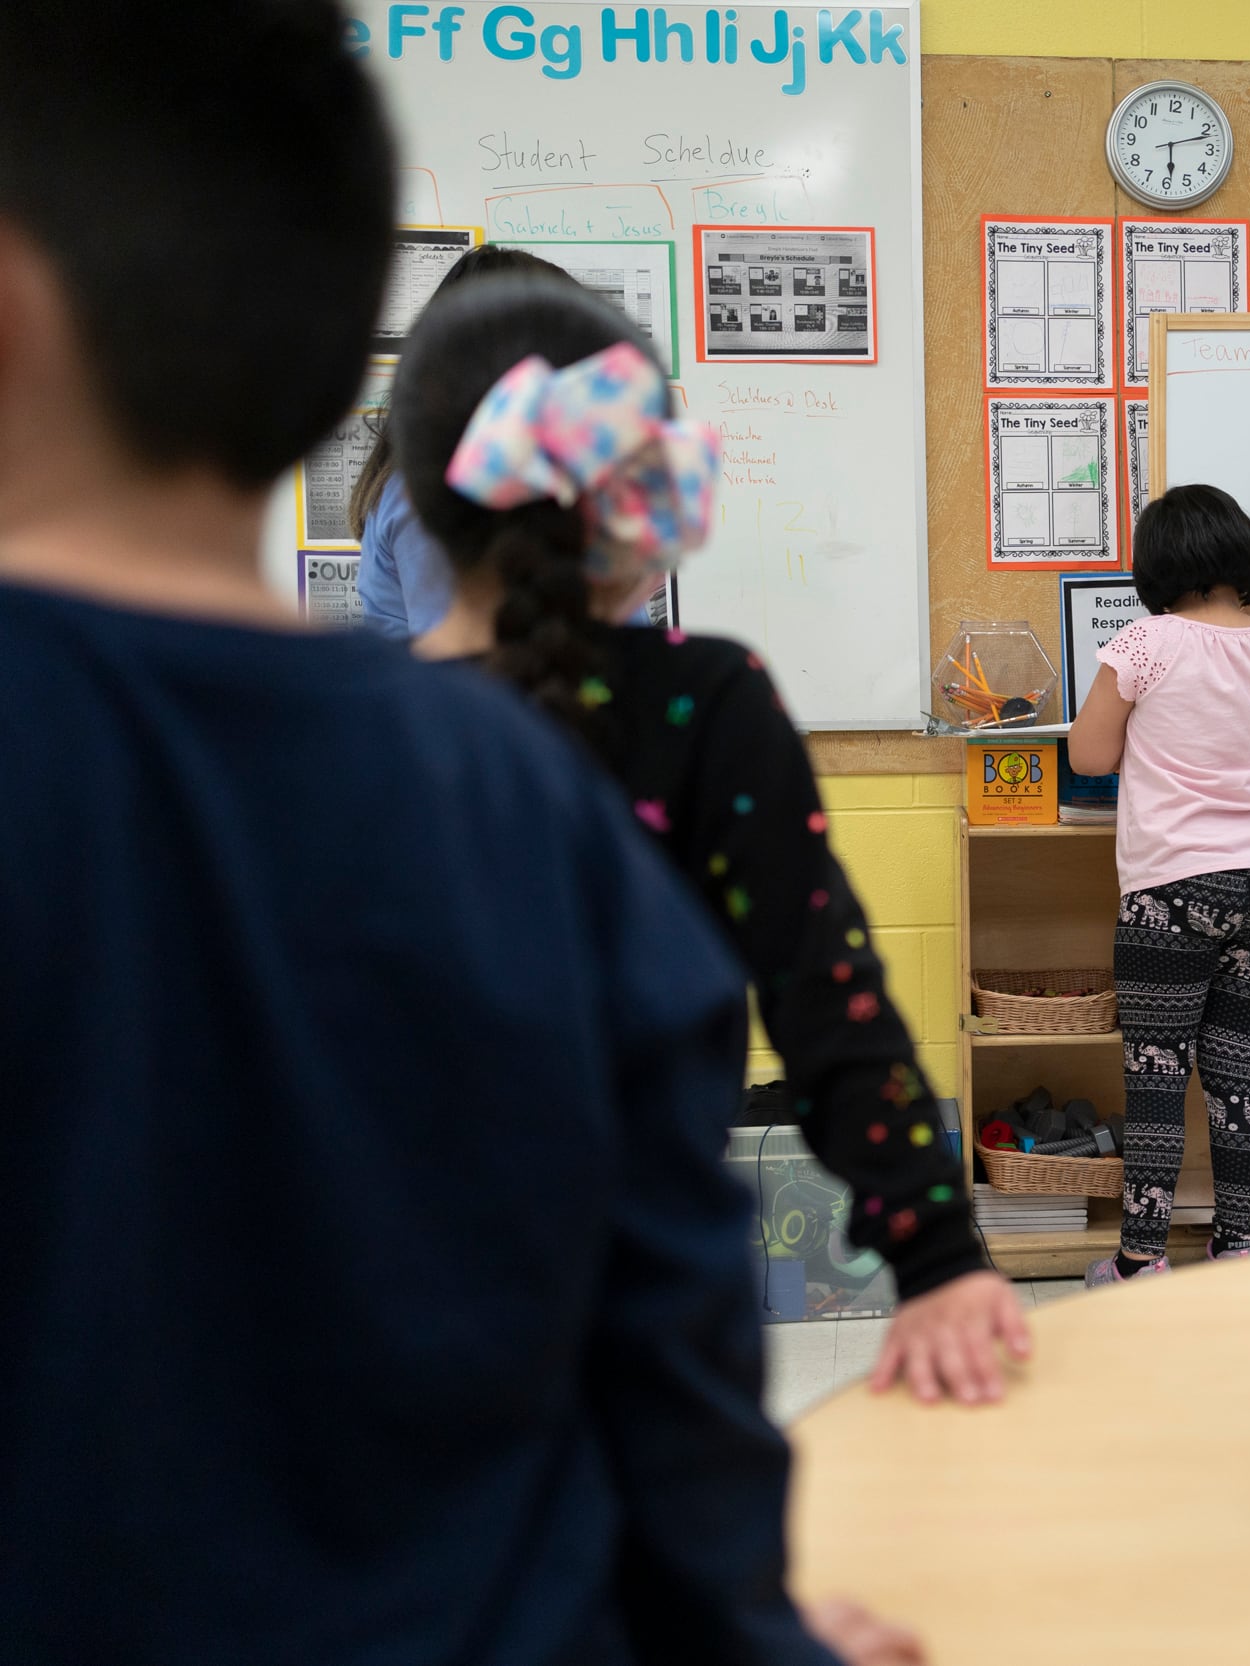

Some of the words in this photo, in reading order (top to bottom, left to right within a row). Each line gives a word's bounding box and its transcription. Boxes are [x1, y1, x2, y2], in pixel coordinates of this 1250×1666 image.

[388, 4, 465, 61] Ff
[482, 5, 582, 80] Gg
[601, 7, 694, 63] Hh
[750, 9, 806, 96] Jj
[817, 9, 907, 65] Kk
[1150, 102, 1158, 116] 11
[1169, 99, 1183, 113] 12
[1134, 115, 1148, 129] 10
[1201, 122, 1212, 136] 2
[1126, 132, 1136, 146] 9
[478, 131, 598, 171] Student
[643, 134, 775, 168] Scheldue
[1205, 143, 1215, 156] 3
[1130, 153, 1140, 167] 8
[1144, 169, 1154, 182] 7
[1197, 162, 1207, 175] 4
[1161, 176, 1171, 190] 6
[1182, 173, 1192, 187] 5
[605, 205, 664, 239] Jesus
[997, 242, 1017, 253] The
[1020, 243, 1043, 255] Tiny
[1046, 243, 1075, 254] Seed
[1134, 241, 1154, 252] The
[1157, 242, 1179, 254] Tiny
[1182, 243, 1211, 253] Seed
[804, 390, 839, 411] Desk
[1000, 417, 1020, 429] The
[1024, 418, 1046, 430] Tiny
[1050, 417, 1079, 429] Seed
[1095, 595, 1144, 609] Readin
[983, 752, 1044, 785] BOB
[983, 785, 1043, 794] BOOKS
